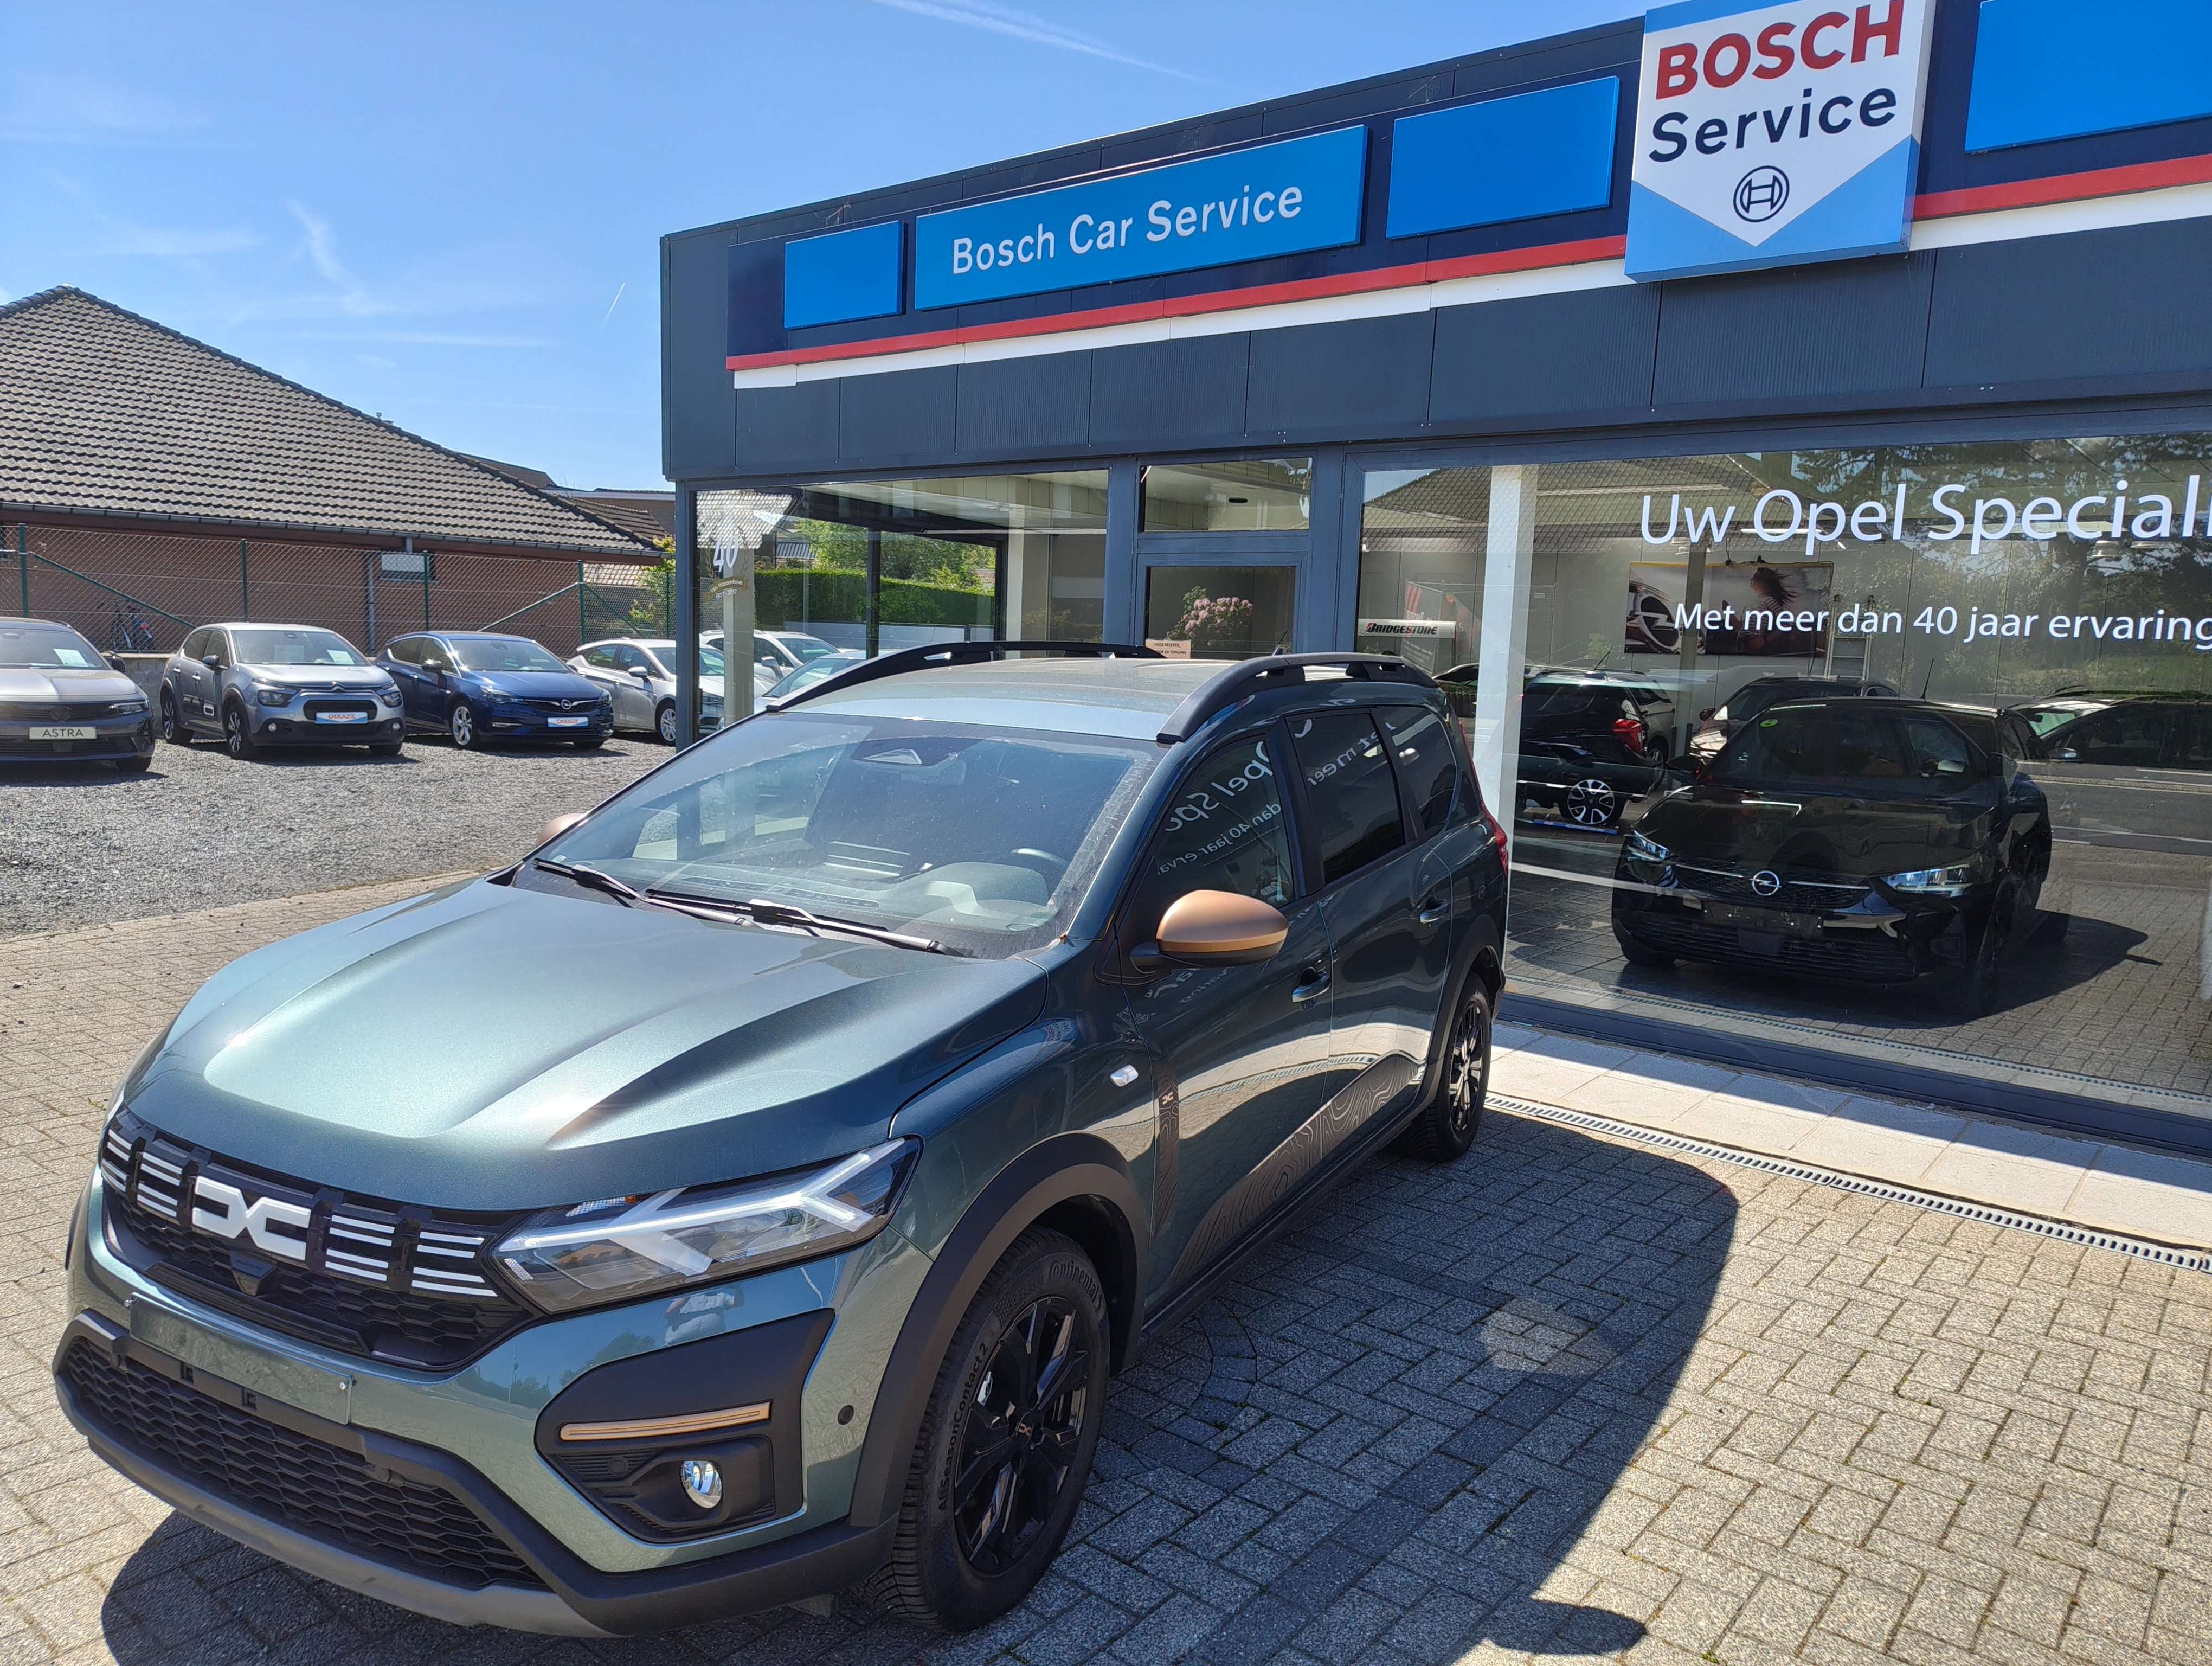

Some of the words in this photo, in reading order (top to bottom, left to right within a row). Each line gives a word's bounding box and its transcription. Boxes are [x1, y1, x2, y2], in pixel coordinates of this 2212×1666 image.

[1656, 0, 1904, 100] BOSCH
[1648, 87, 1897, 163] Service
[953, 223, 1055, 274] Bosch
[1069, 215, 1133, 254] Car
[1146, 185, 1302, 242] Service
[1641, 494, 1736, 544] Uw
[1753, 484, 1907, 556] Opel
[713, 534, 739, 573] 40
[1365, 622, 1438, 635] BRIDGESTONE
[1674, 603, 1735, 630] Met
[1744, 608, 1829, 632] meer
[1838, 603, 1903, 633] dan
[1913, 606, 1958, 635] 40
[1963, 606, 2039, 643] jaar
[2048, 608, 2212, 650] ervaring
[42, 728, 83, 737] ASTRA
